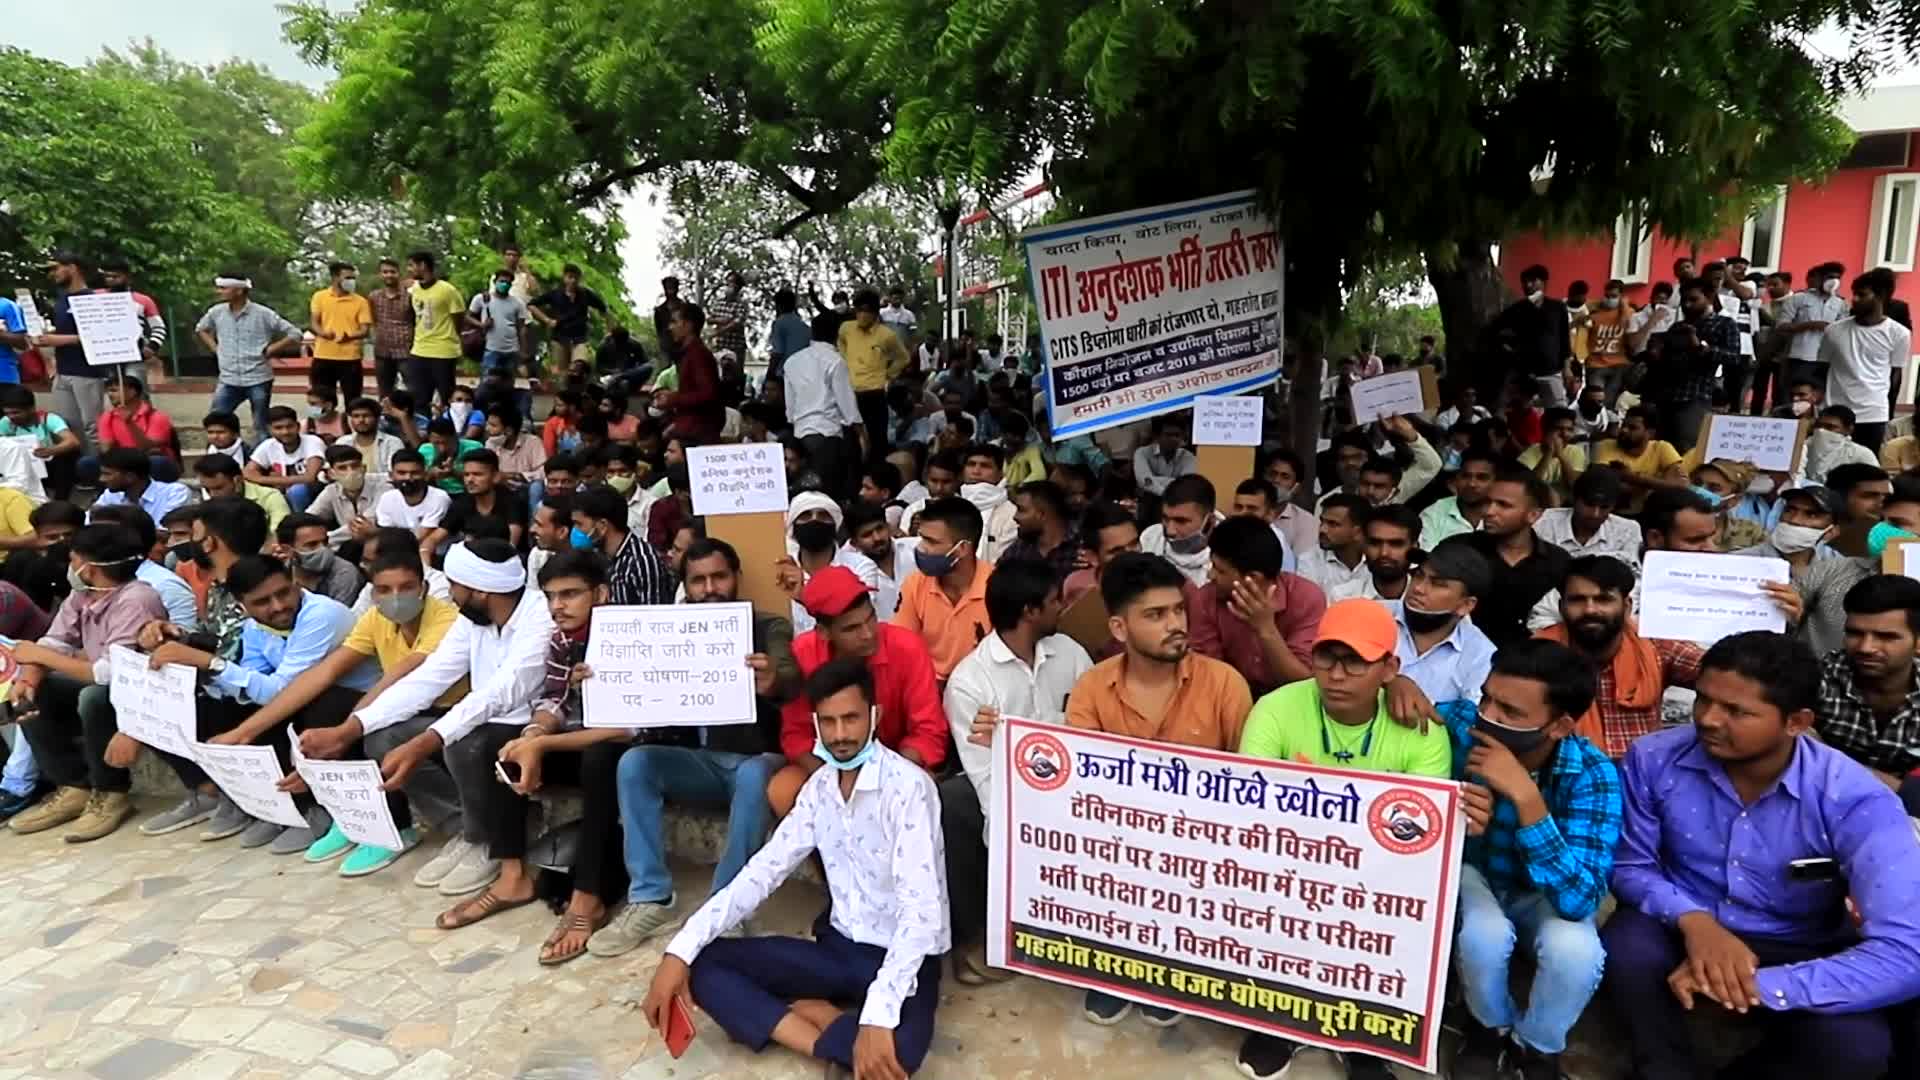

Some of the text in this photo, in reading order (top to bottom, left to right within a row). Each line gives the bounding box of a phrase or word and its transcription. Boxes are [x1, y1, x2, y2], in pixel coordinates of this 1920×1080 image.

[1040, 264, 1072, 320] ITI
[1076, 250, 1164, 321] अनुदेशक
[1205, 227, 1250, 283] जारी
[1051, 334, 1078, 361] CITS
[1081, 325, 1125, 354] डिप्लोमा
[1062, 383, 1089, 399] 1500
[1114, 371, 1131, 383] पर
[1167, 355, 1197, 370] 2019
[648, 621, 674, 635] राज
[679, 621, 708, 634] JEN
[713, 616, 738, 633] भर्ती
[661, 639, 695, 659] जारी
[704, 637, 735, 656] करो
[623, 694, 642, 707] पद
[680, 693, 714, 706] 2100
[319, 771, 344, 782] JEN
[1076, 749, 1136, 786] ऊर्जा
[1140, 757, 1191, 796] मंत्री
[1274, 777, 1361, 824] खोलो
[1172, 809, 1233, 846] हेल्पर
[1238, 823, 1272, 853] की
[1276, 827, 1363, 870] विज्ञप्ति
[1020, 823, 1427, 921] 6000 पदों पर आयु सीमा में छूट के साथ
[1040, 864, 1395, 956] भर्ती परीक्षा 2013 पेटर्न पर परीक्षा
[1028, 896, 1407, 999] ऑफलाईन हो, विज्ञप्ति जल्द जारी हो
[1015, 931, 1419, 1045] गहलोत सरकार बजट घोषणा पूरी करों
